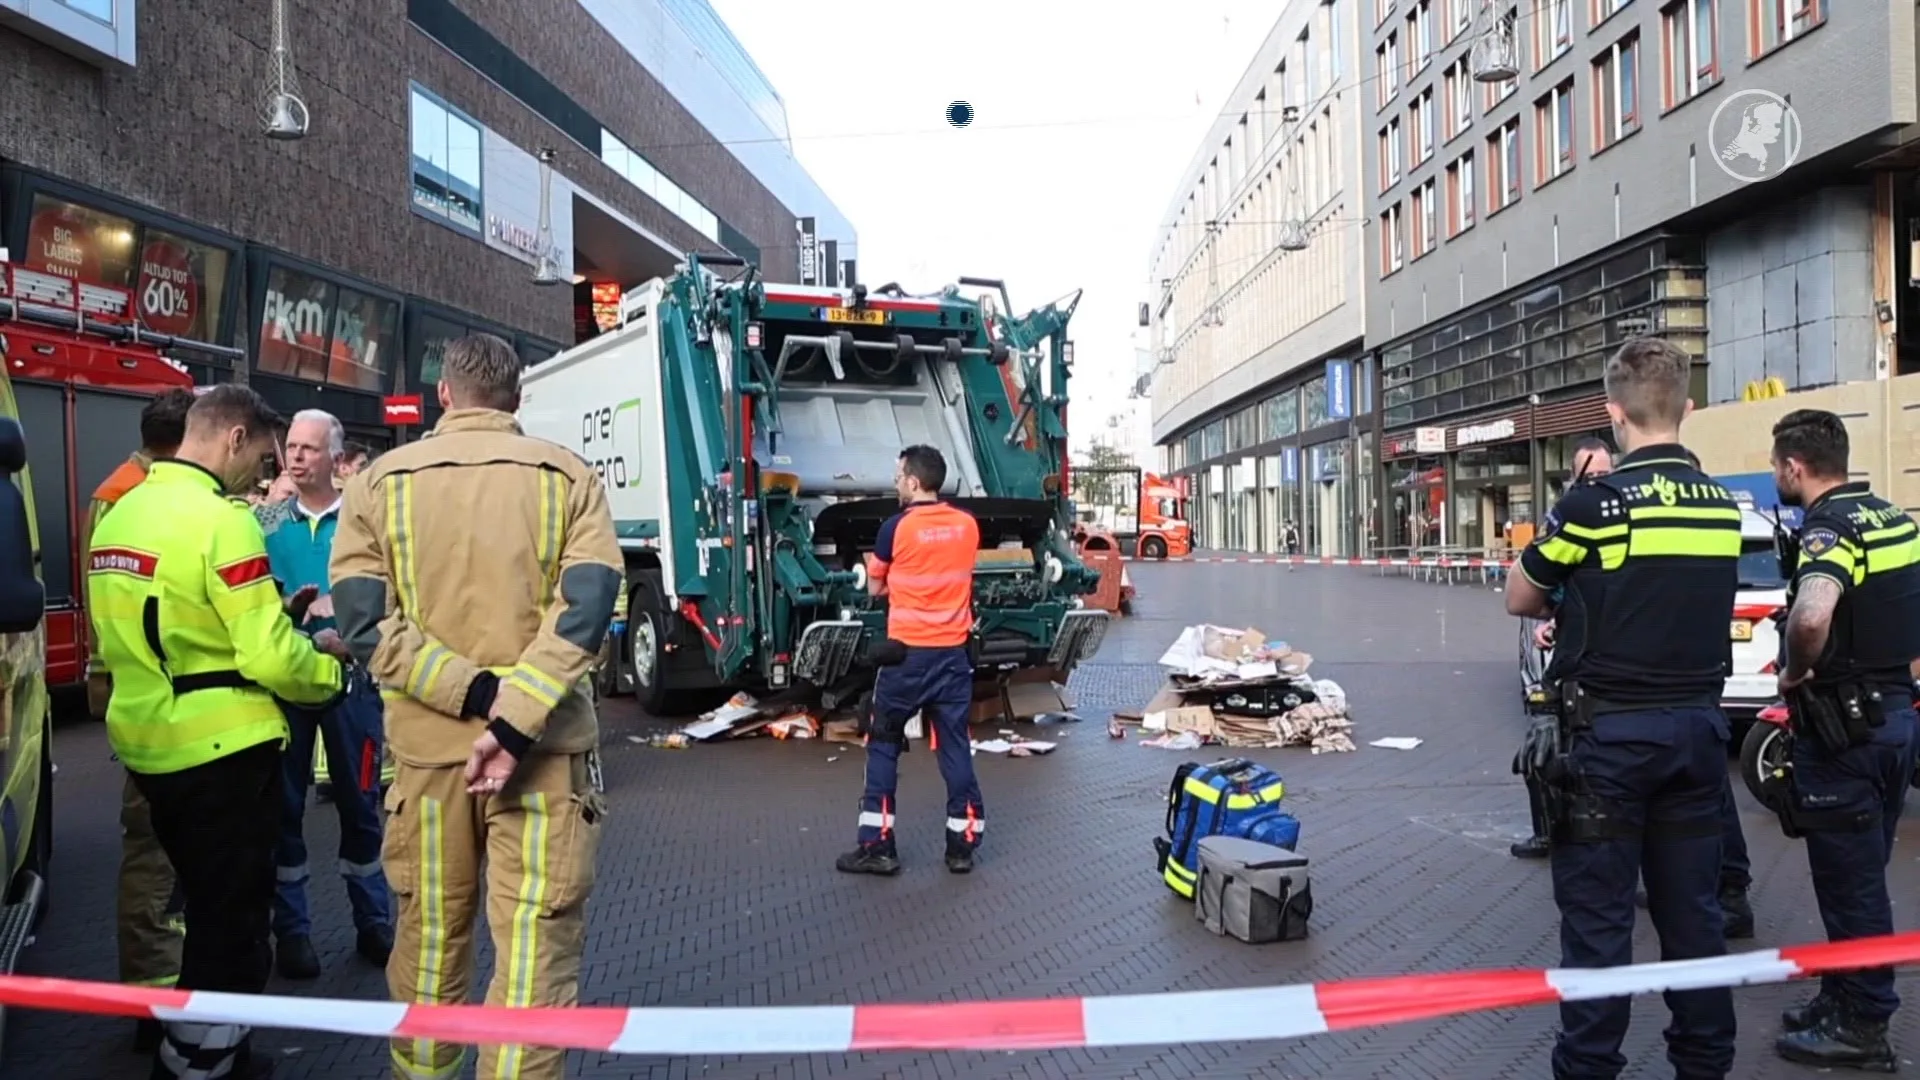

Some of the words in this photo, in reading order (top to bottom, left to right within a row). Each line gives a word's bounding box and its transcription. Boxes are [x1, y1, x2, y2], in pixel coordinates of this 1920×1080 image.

[53, 226, 72, 245] BIG
[144, 261, 171, 280] ALTIJD
[172, 269, 188, 284] TOT
[143, 278, 188, 316] 60%
[583, 407, 611, 454] pre
[587, 456, 627, 489] ero
